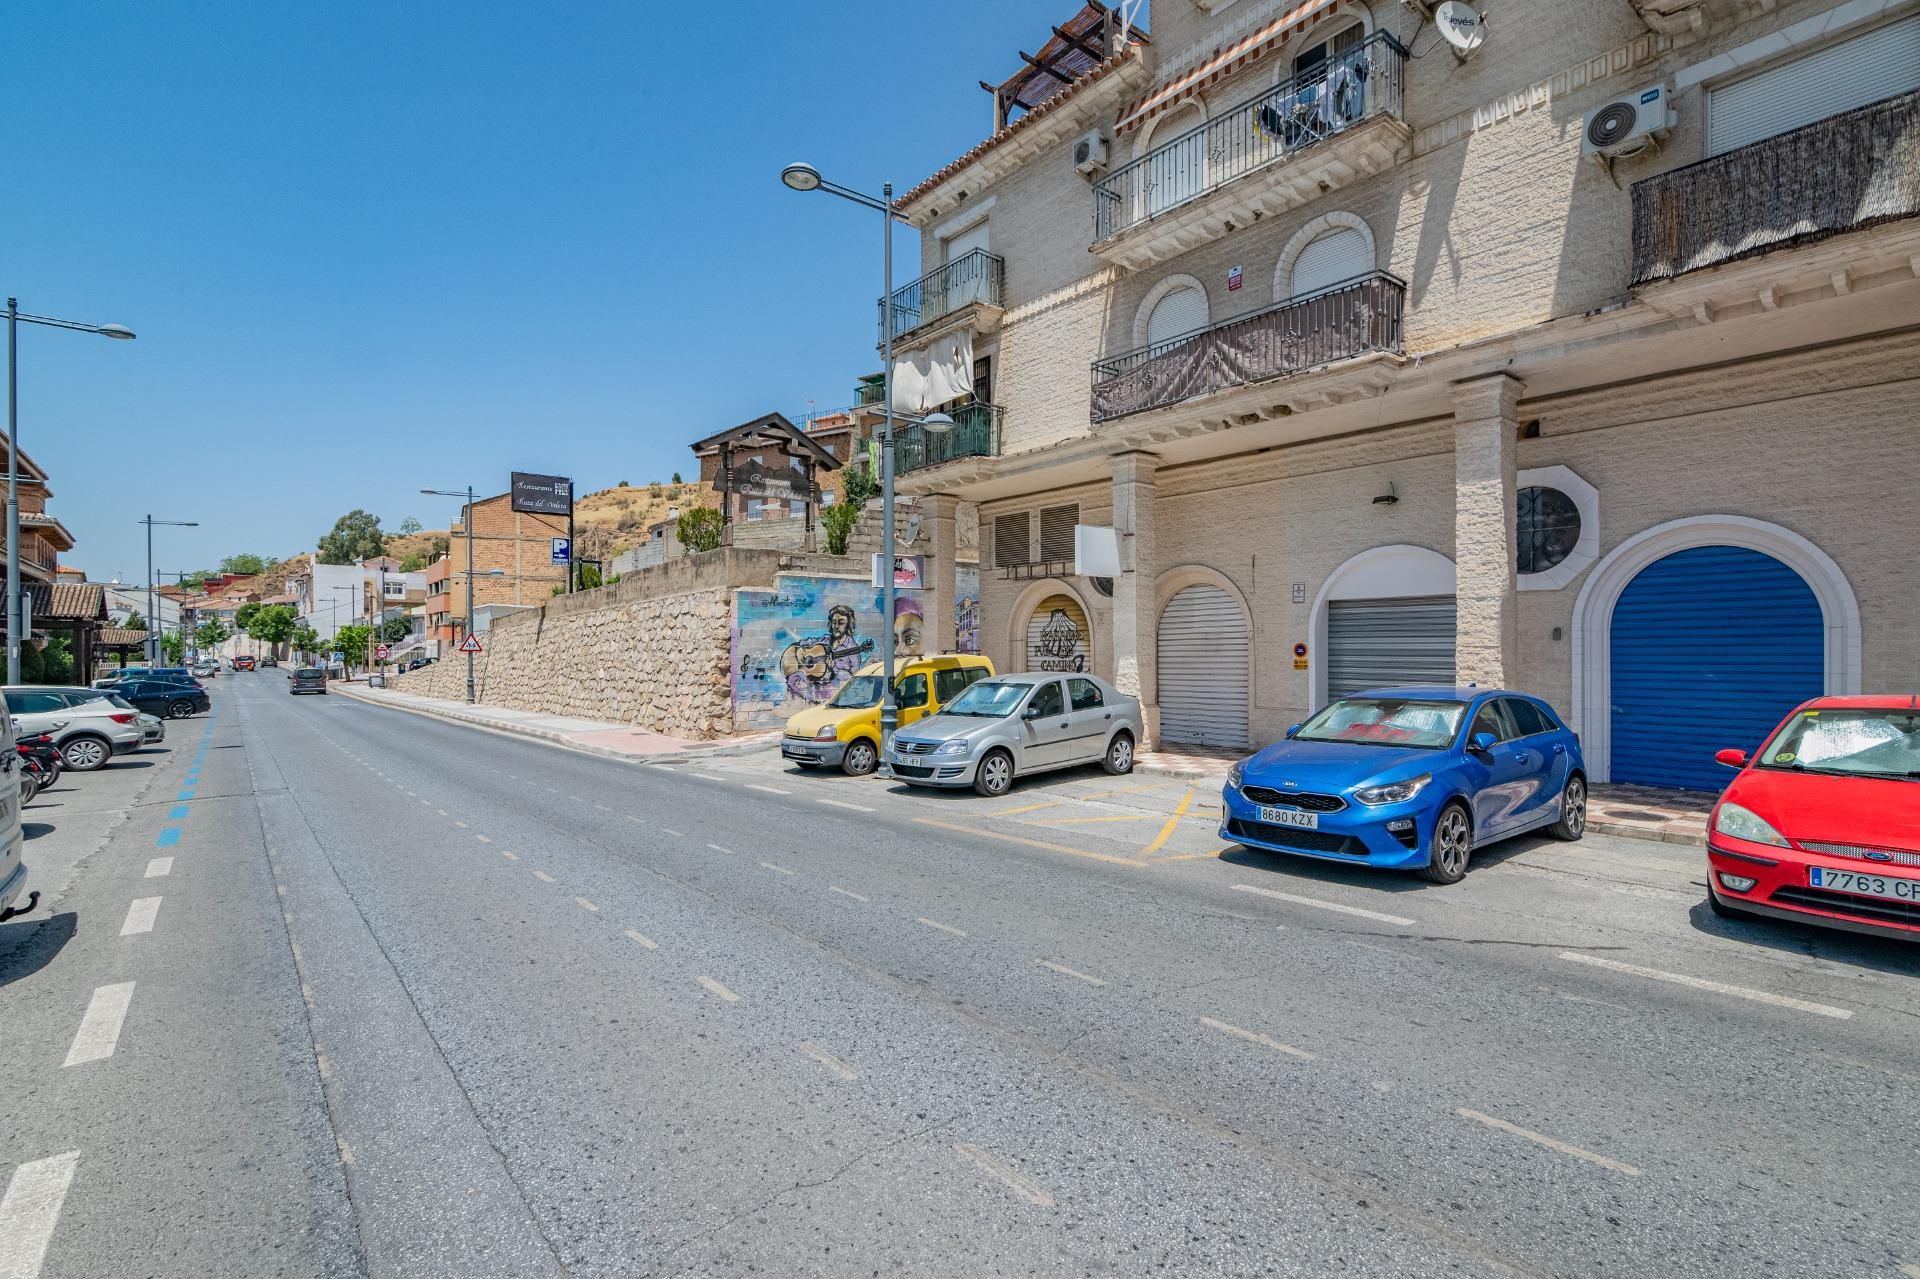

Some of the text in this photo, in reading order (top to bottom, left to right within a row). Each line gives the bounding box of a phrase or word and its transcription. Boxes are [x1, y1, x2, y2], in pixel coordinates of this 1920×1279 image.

[1442, 11, 1475, 27] Televés
[553, 538, 568, 553] P
[1262, 808, 1313, 826] 8680 KZX
[1826, 871, 1886, 895] 7763
